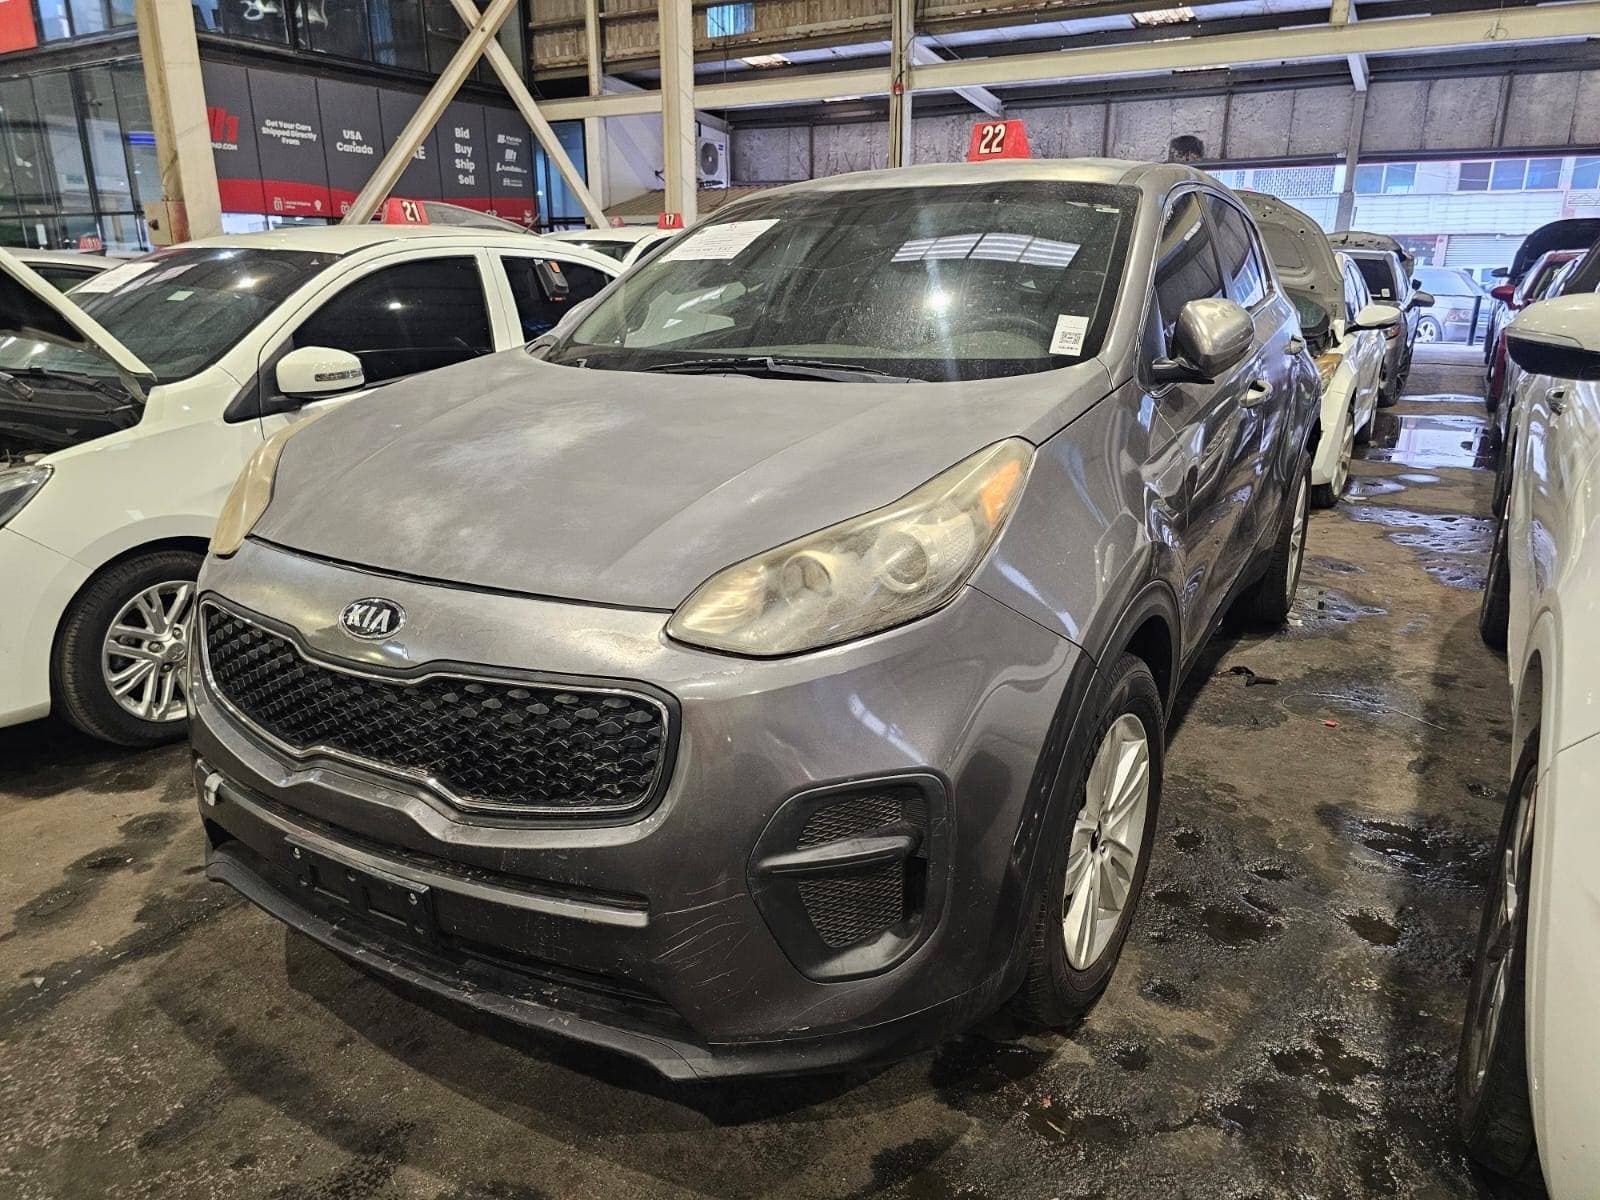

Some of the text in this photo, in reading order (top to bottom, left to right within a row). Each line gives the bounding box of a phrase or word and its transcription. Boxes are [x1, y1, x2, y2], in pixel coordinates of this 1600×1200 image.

[279, 121, 295, 129] Your
[296, 123, 311, 131] Cars
[455, 127, 470, 139] Bid
[261, 127, 317, 142] Shipped Directly
[281, 136, 300, 145] From
[343, 129, 362, 140] USA
[979, 124, 1006, 154] 22
[336, 141, 373, 155] Canada
[455, 142, 473, 157] Buy
[455, 158, 475, 173] Ship
[458, 174, 475, 185] Sell
[402, 201, 421, 221] 21
[665, 214, 674, 225] 17
[347, 604, 391, 632] KIA
